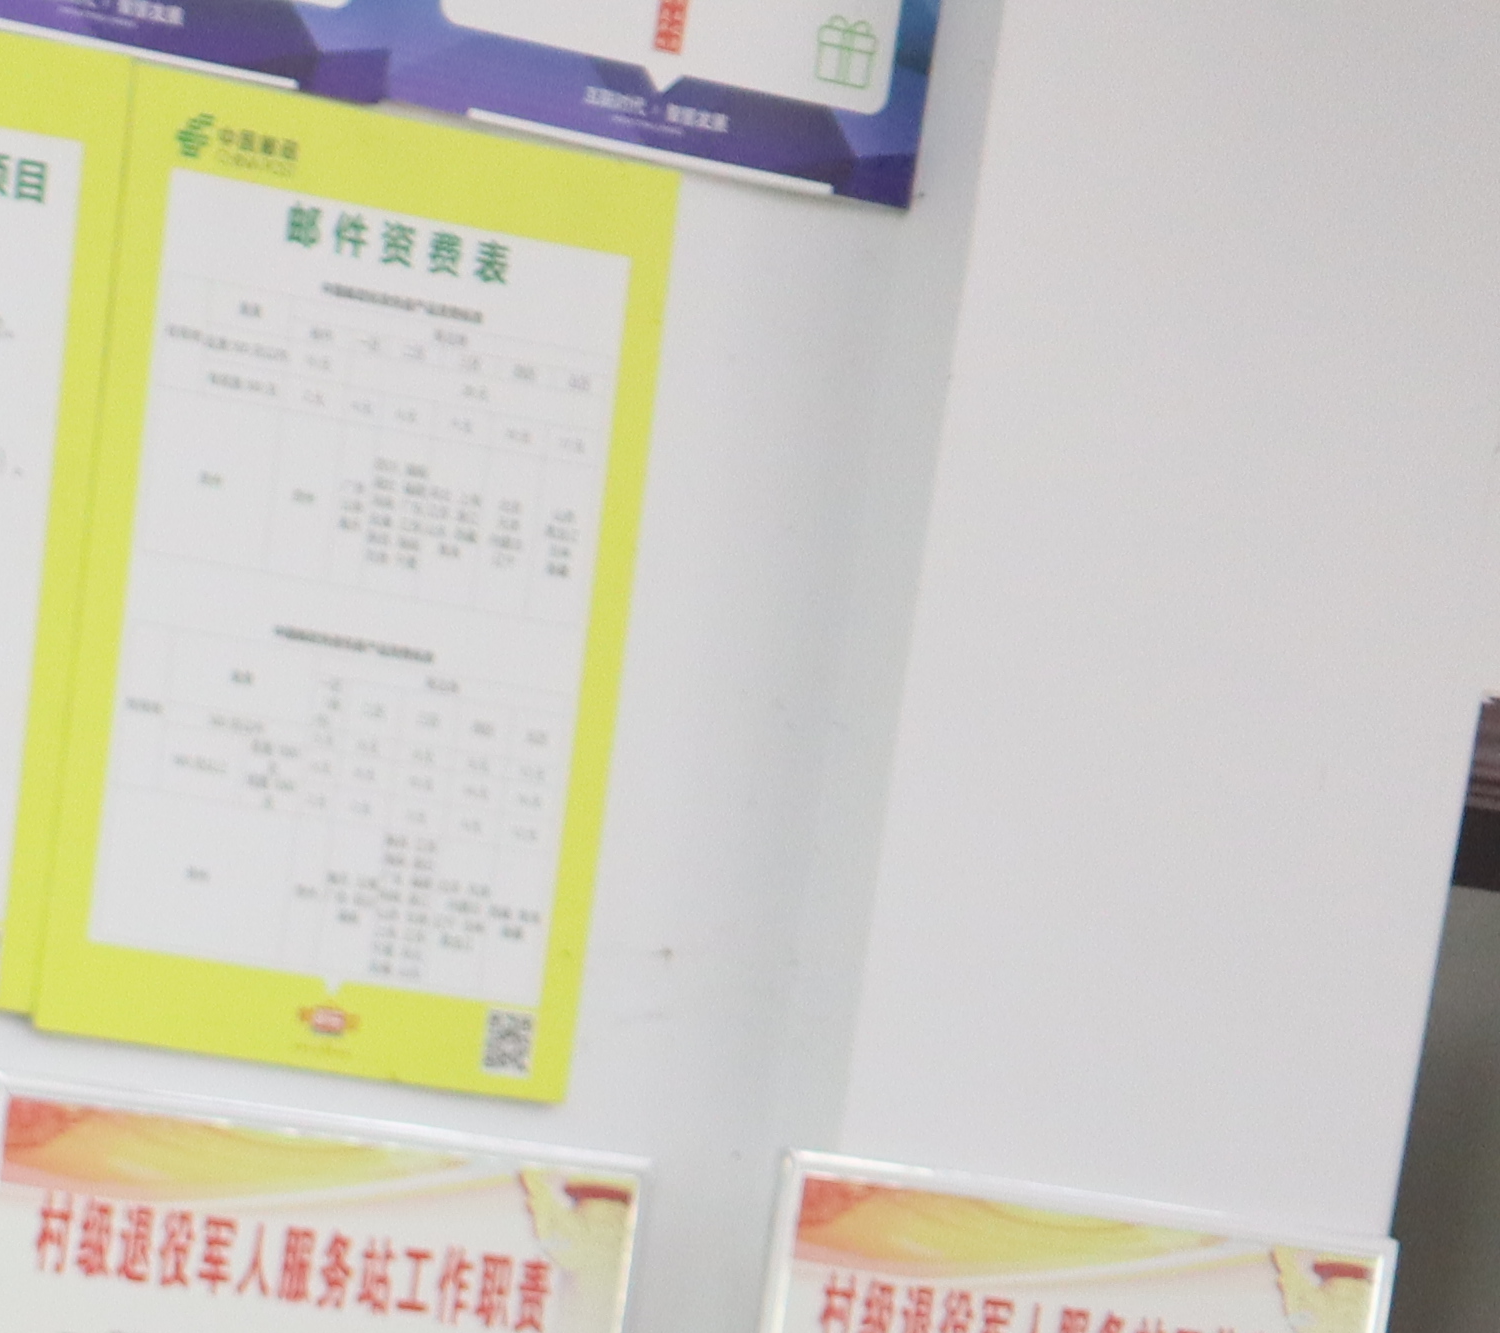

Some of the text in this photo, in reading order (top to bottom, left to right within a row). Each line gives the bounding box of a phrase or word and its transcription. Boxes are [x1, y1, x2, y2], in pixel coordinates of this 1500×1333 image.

[286, 202, 511, 286] 邮件资费表
[36, 1190, 554, 1333] 村级退役军人服务站工作职责
